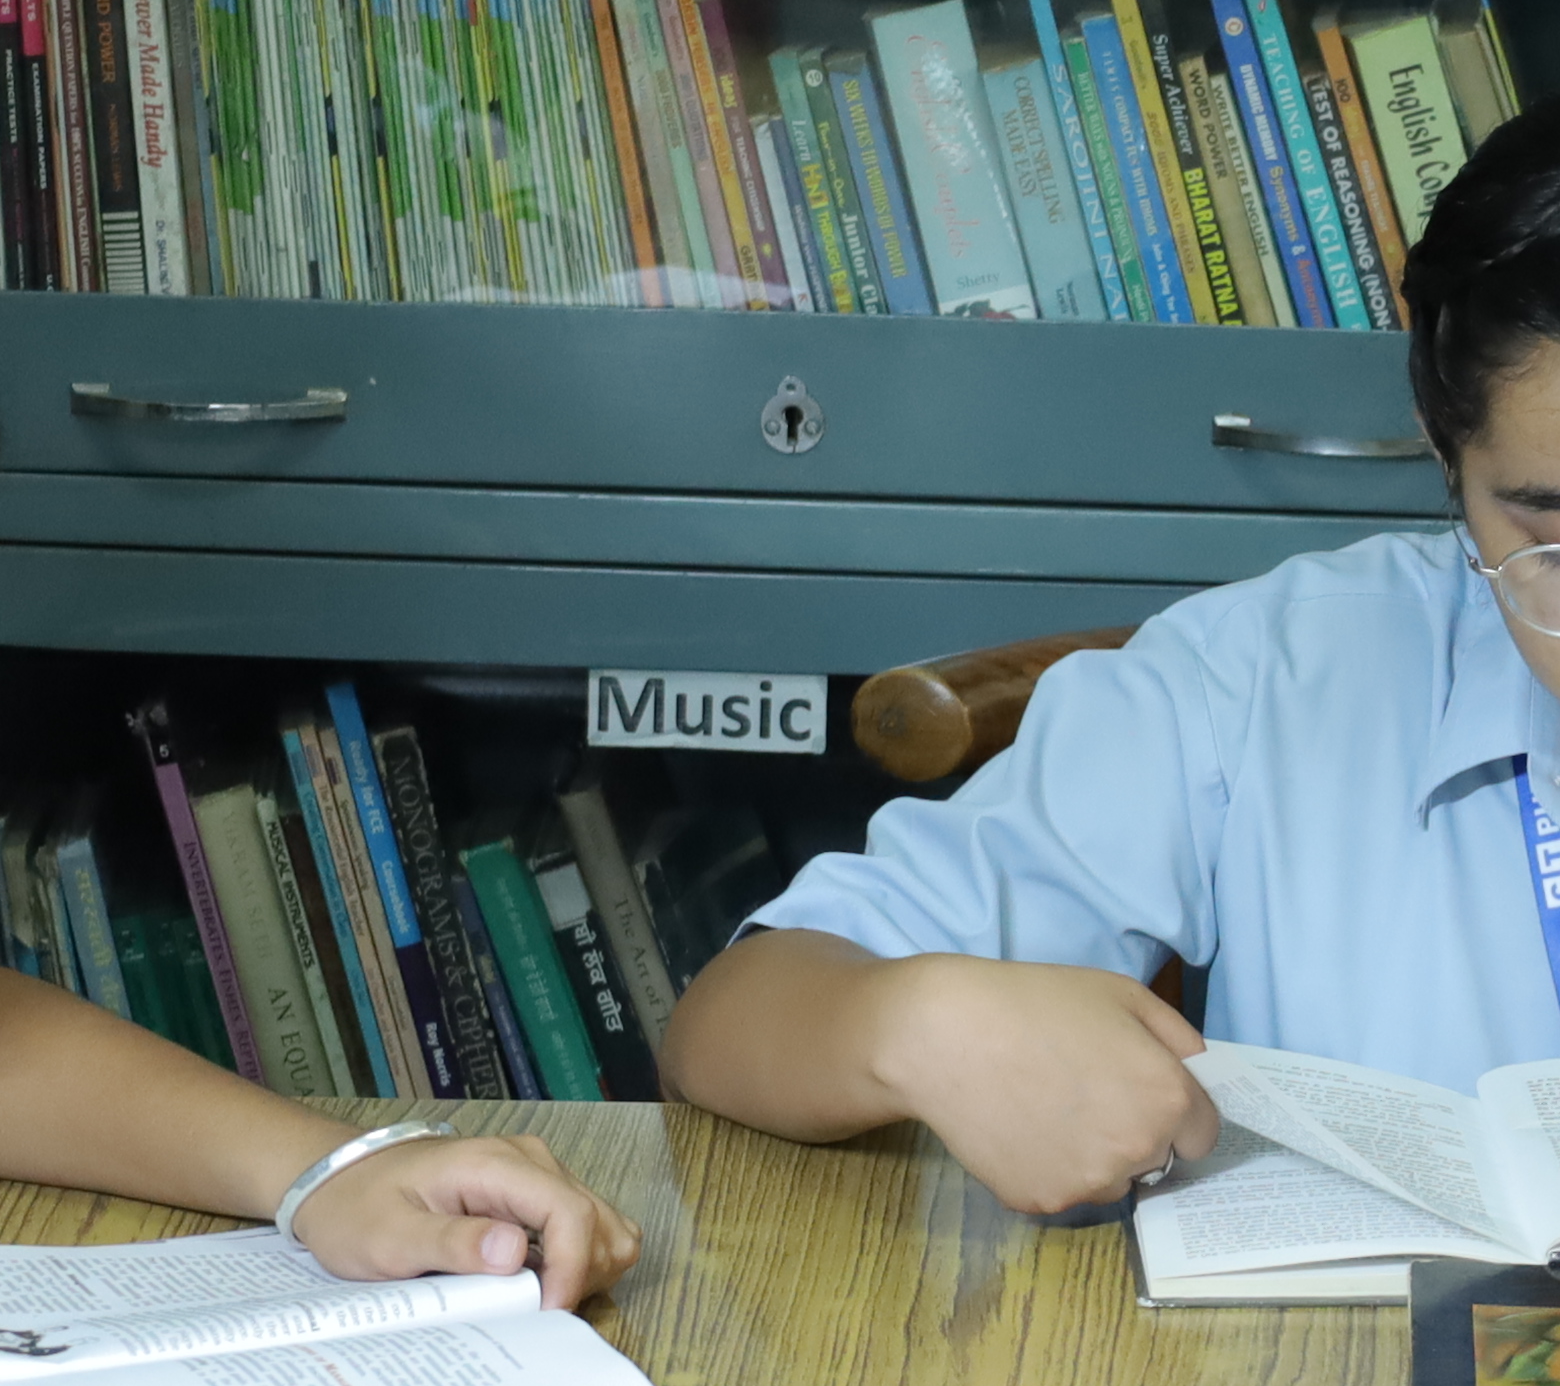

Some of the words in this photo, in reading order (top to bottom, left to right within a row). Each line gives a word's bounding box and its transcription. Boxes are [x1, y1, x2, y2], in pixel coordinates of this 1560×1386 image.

[97, 22, 116, 83] POWER
[138, 43, 162, 97] Made
[141, 102, 167, 168] Handy
[1002, 109, 1023, 155] MADE
[1014, 76, 1044, 148] CORRECT
[1188, 69, 1212, 119] WORD
[1202, 123, 1228, 179] POWER
[1310, 84, 1333, 121] TEST
[1386, 63, 1441, 157] English
[1264, 34, 1305, 140] TEACHING
[1297, 149, 1316, 176] OF
[1307, 187, 1354, 308] ENGLISH
[1322, 128, 1340, 153] OF
[1011, 159, 1036, 198] EASY
[1028, 149, 1065, 224] SPELLING
[1153, 35, 1174, 81] Super
[1164, 84, 1195, 154] Achiever
[1184, 167, 1222, 246] BHARAT
[1207, 251, 1239, 314] RATNA
[842, 213, 870, 278] Junior
[1330, 158, 1375, 270] REASONING
[597, 675, 812, 741] Music
[266, 821, 291, 877] MUSICAL
[281, 881, 316, 970] INSTRUMENTS
[425, 1022, 440, 1044] Roy
[430, 1048, 451, 1086] Norris
